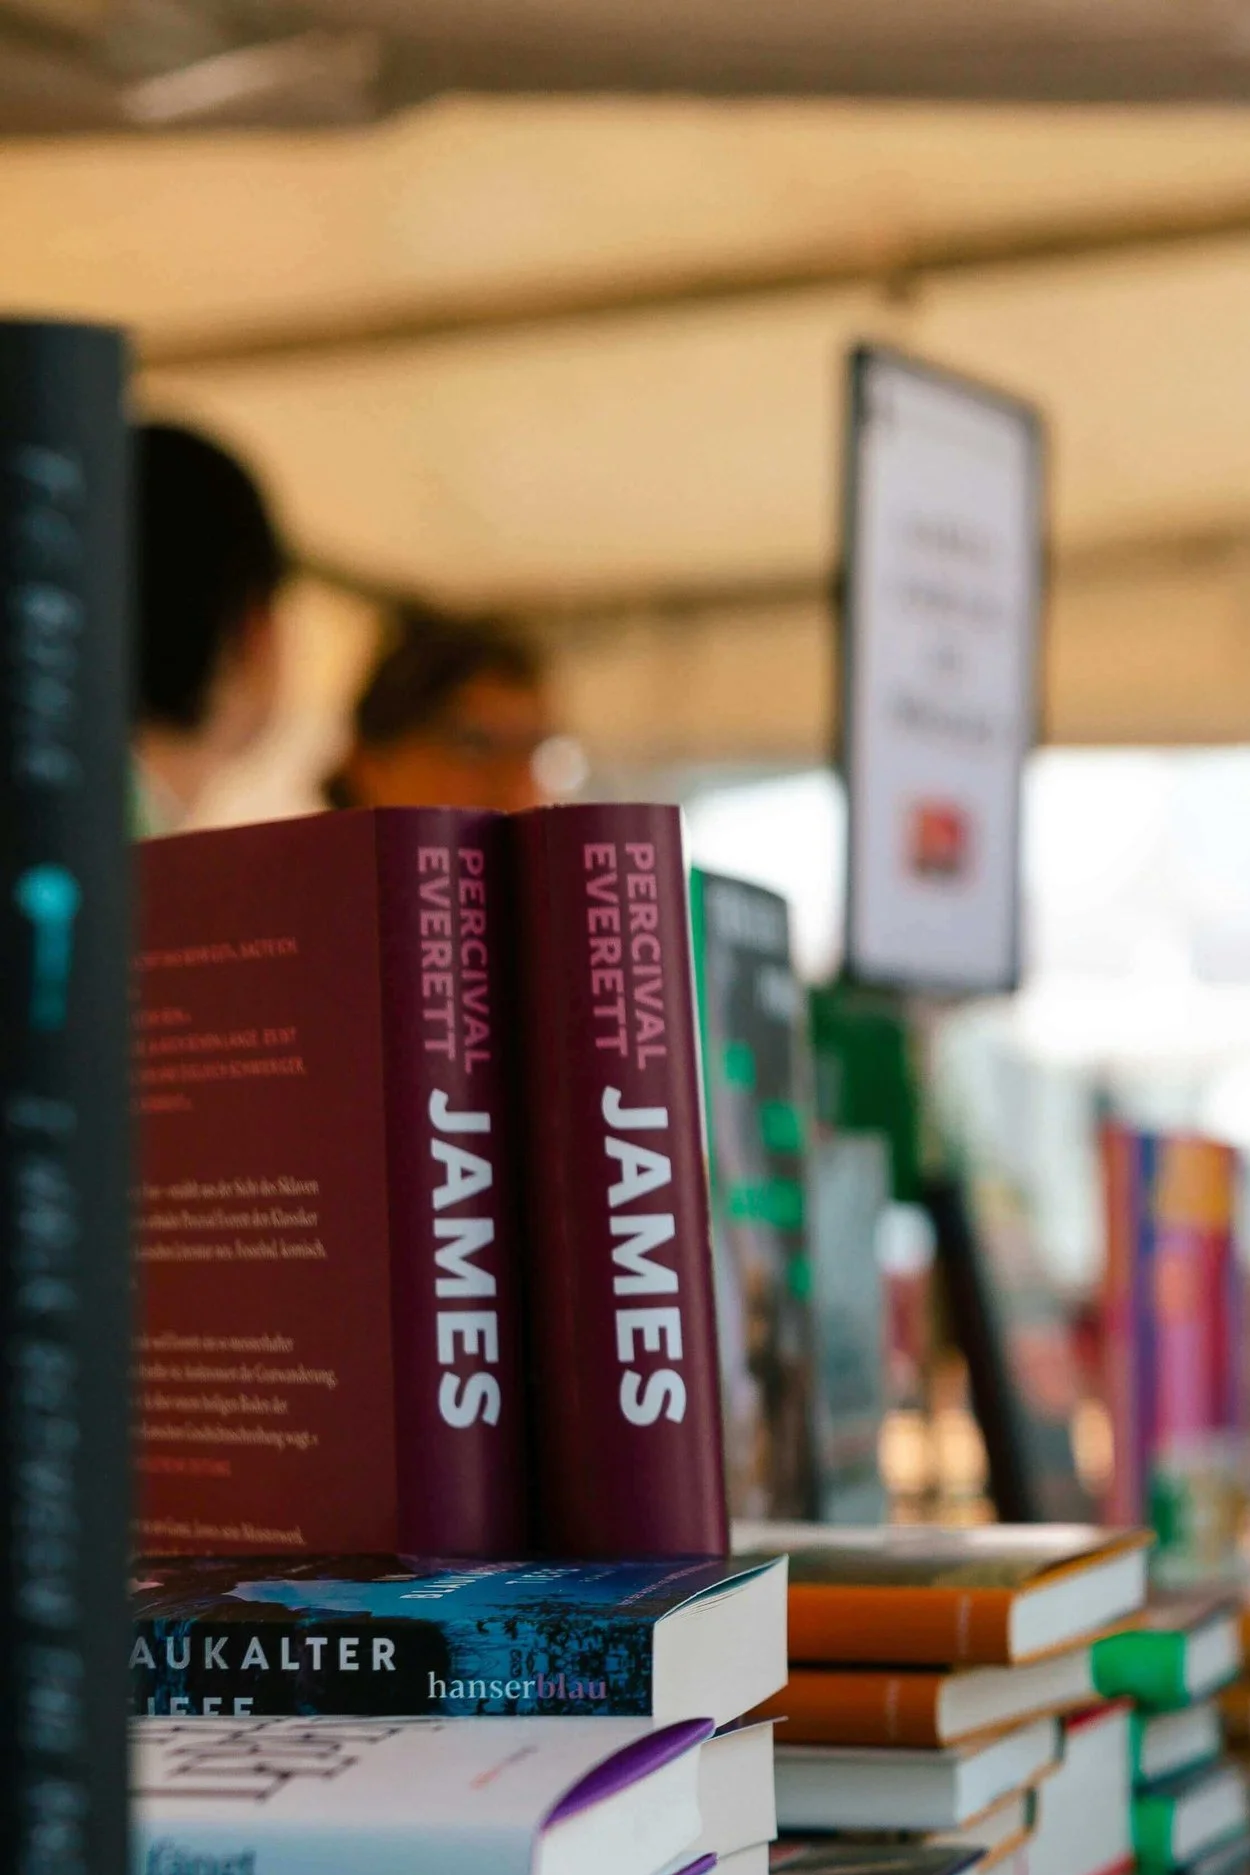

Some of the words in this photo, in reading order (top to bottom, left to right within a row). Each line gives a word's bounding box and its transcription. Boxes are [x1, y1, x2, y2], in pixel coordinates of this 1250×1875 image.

[416, 845, 457, 1062] EVERETT
[457, 847, 493, 1076] PERCIVAL
[583, 843, 628, 1058] EVERETT
[624, 841, 668, 1071] PERCIVAL
[428, 1087, 503, 1430] JAMES
[601, 1086, 687, 1427] JAMES
[128, 1635, 397, 1672] AUKALTER
[428, 1671, 608, 1701] hanserblau
